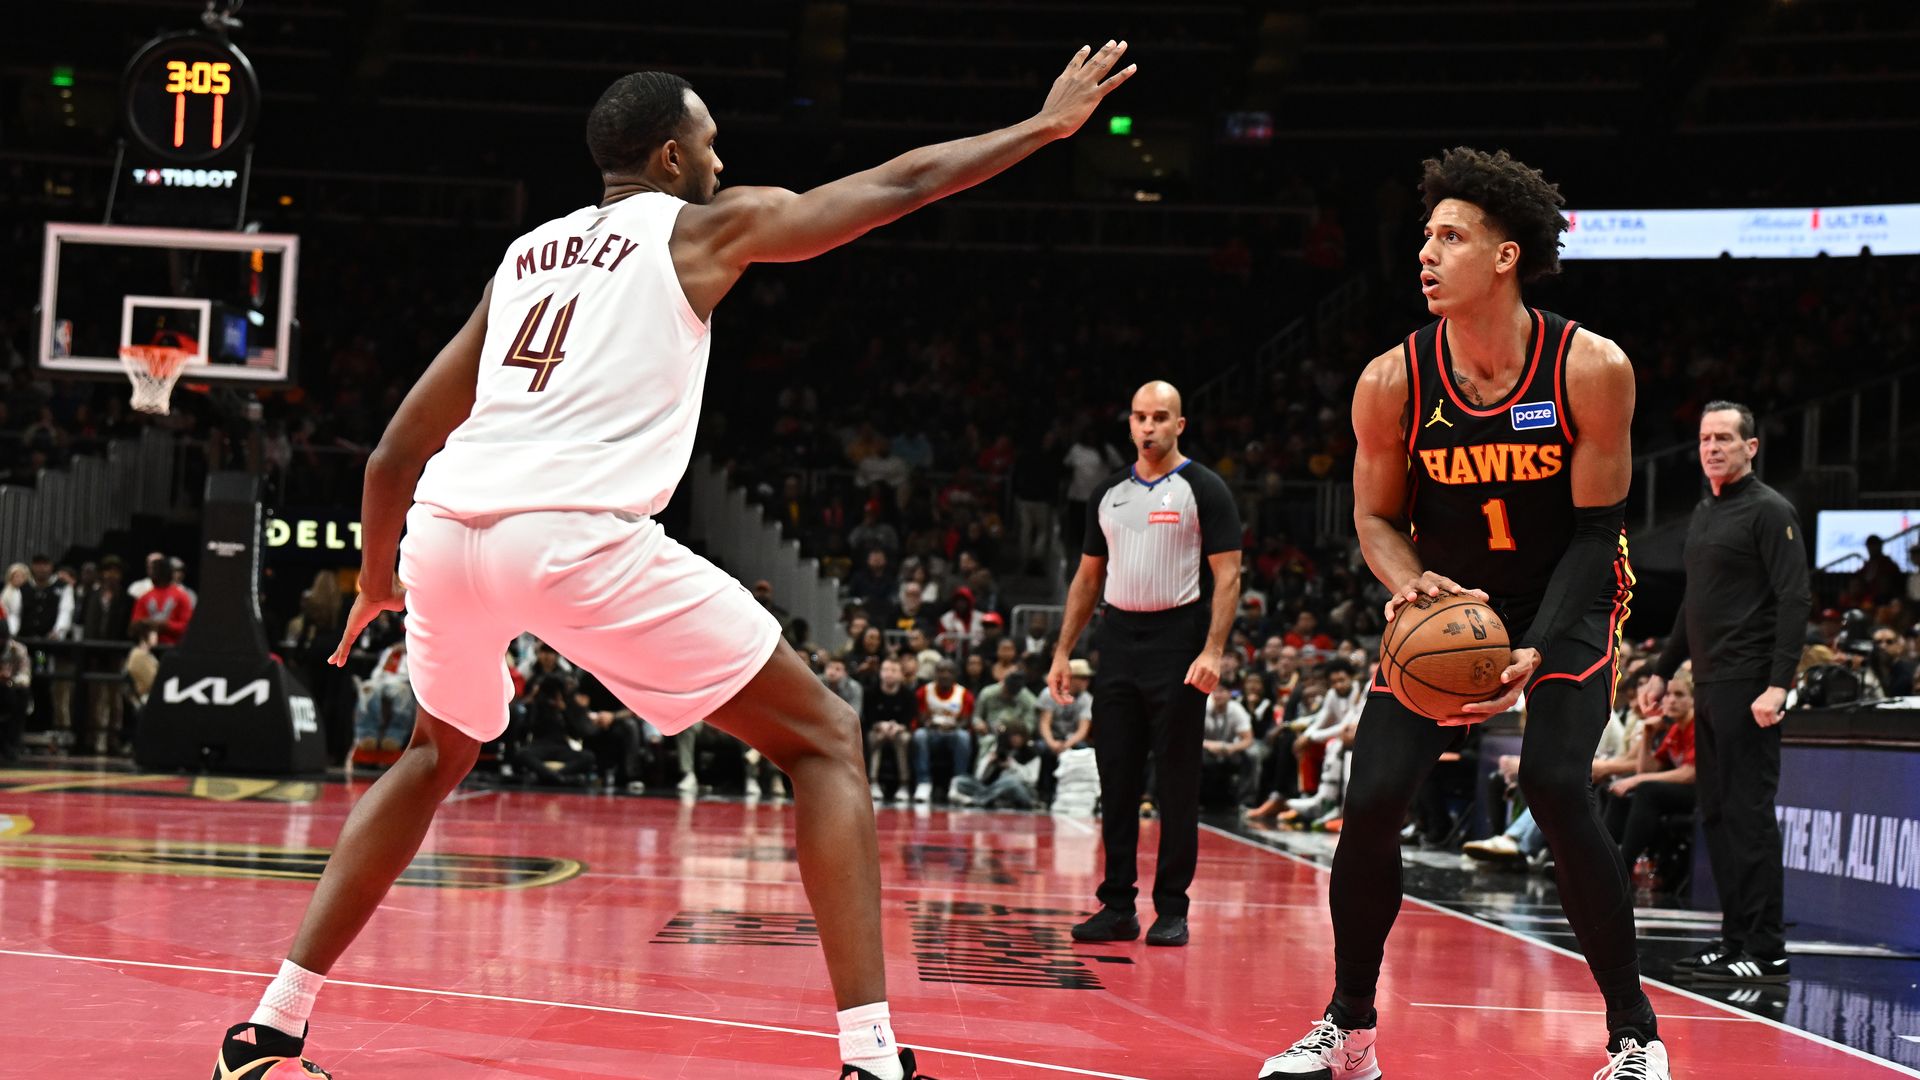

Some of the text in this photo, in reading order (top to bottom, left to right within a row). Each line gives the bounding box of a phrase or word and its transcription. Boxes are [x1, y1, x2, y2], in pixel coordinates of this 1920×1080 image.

[166, 61, 231, 94] 3:05
[174, 92, 224, 149] 11
[515, 233, 640, 281] MOBLEY
[502, 292, 580, 392] 4
[1515, 407, 1552, 424] paze
[1418, 443, 1563, 486] HAWKS
[266, 518, 362, 550] DELT
[1481, 498, 1516, 551] 1
[163, 676, 270, 706] KIA
[1782, 806, 1811, 870] THE
[1845, 813, 1877, 882] ALL
[1876, 816, 1899, 885] IN
